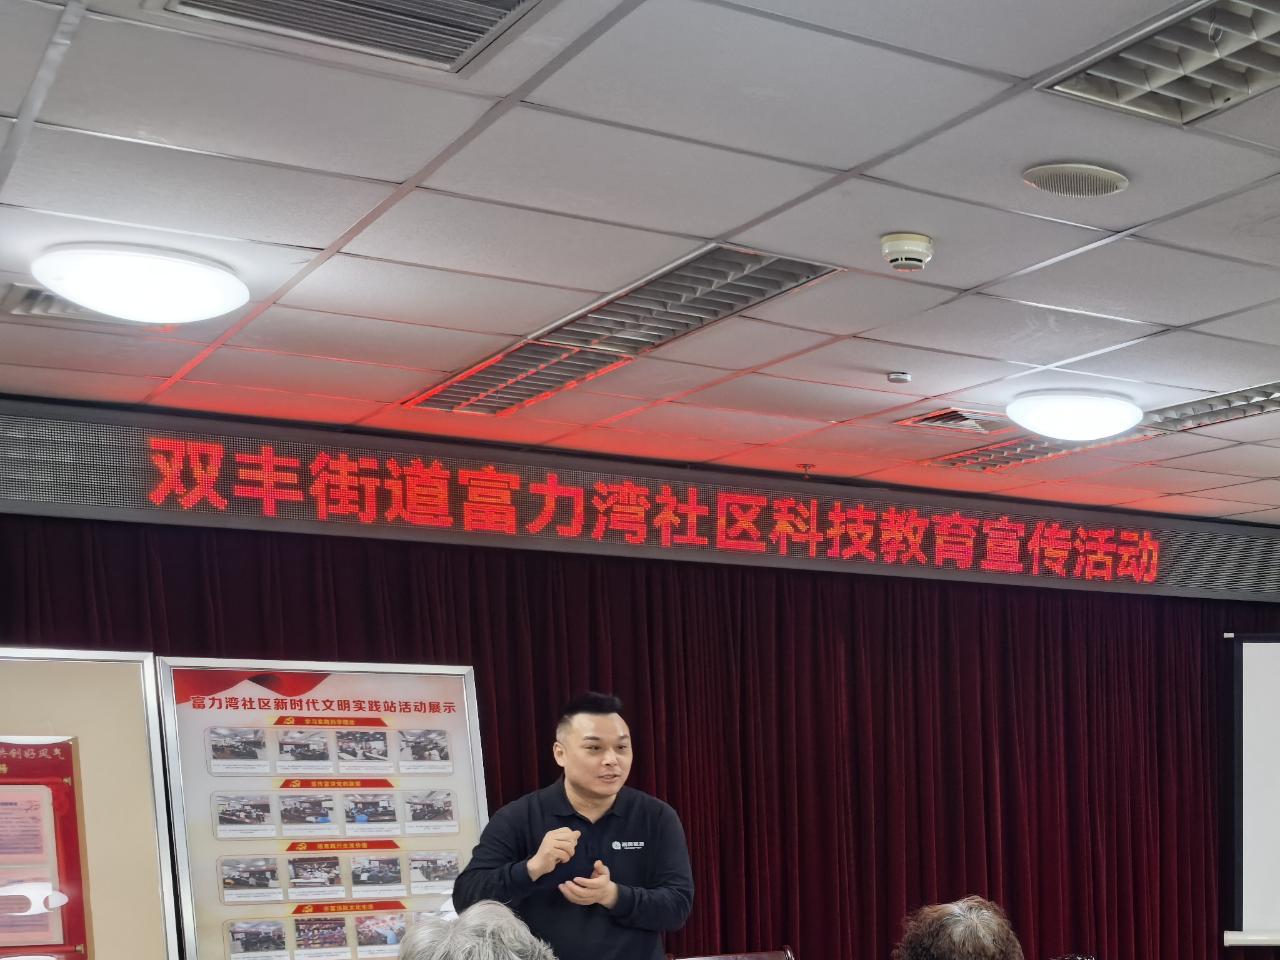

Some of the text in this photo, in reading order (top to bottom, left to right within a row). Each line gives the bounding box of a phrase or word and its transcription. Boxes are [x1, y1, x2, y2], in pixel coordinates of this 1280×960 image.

[146, 437, 1160, 585] 双丰街道富力湾社区科技教育宣传活动
[191, 696, 457, 714] 富力湾社区新时代文明实践站活动展示
